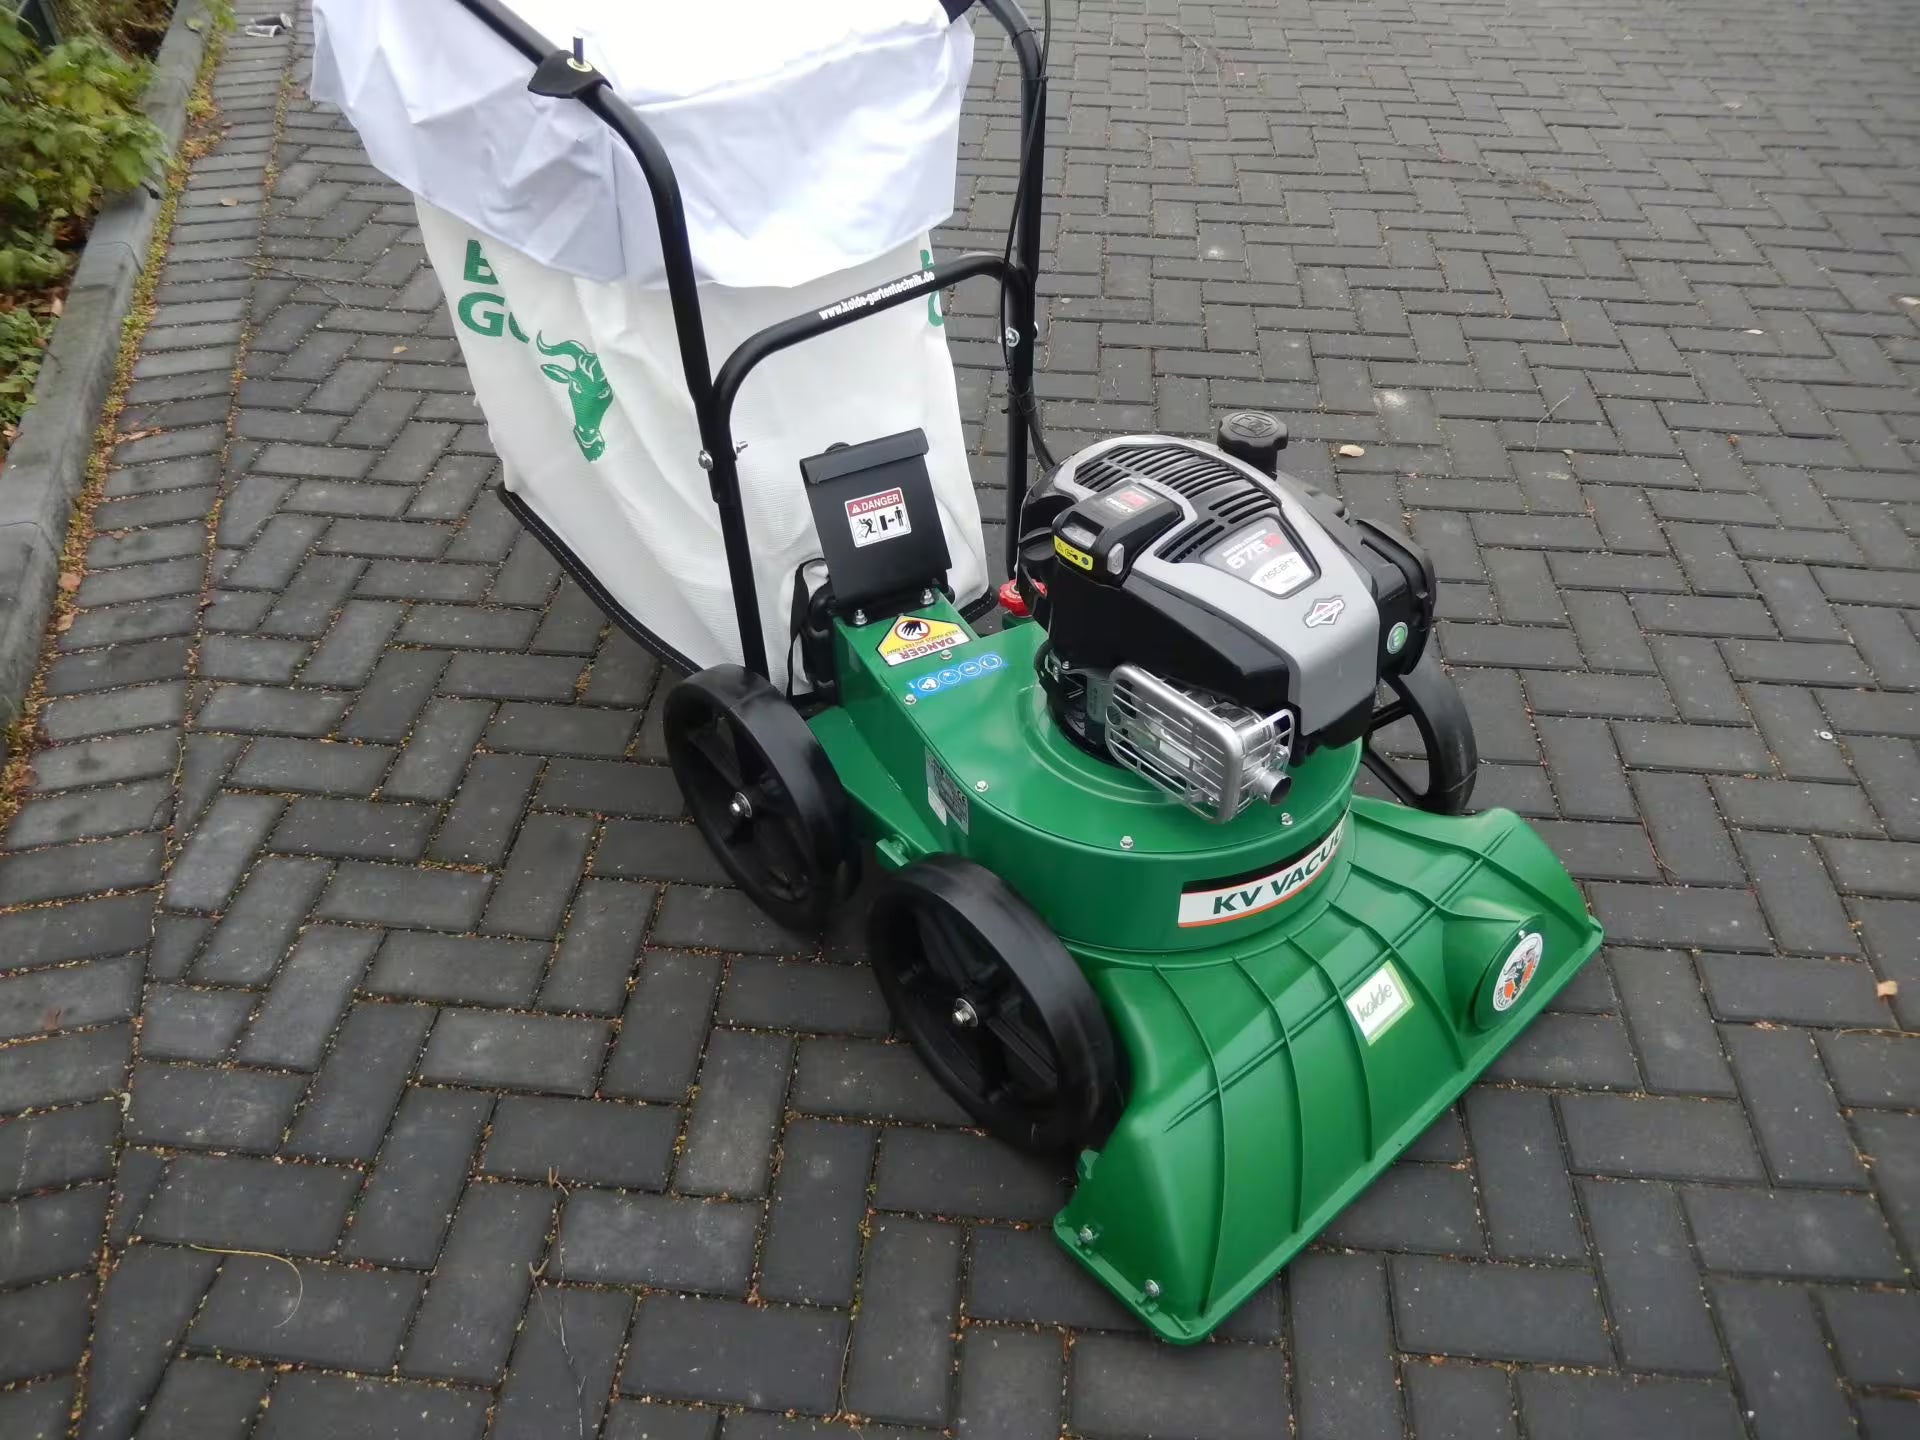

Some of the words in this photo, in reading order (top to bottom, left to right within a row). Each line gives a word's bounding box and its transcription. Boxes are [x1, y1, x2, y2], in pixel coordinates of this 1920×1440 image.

[819, 271, 935, 320] www.kolde-gartentechnik.de
[861, 493, 900, 512] DANGER
[899, 636, 956, 660] DANGER
[1213, 885, 1263, 915] KV
